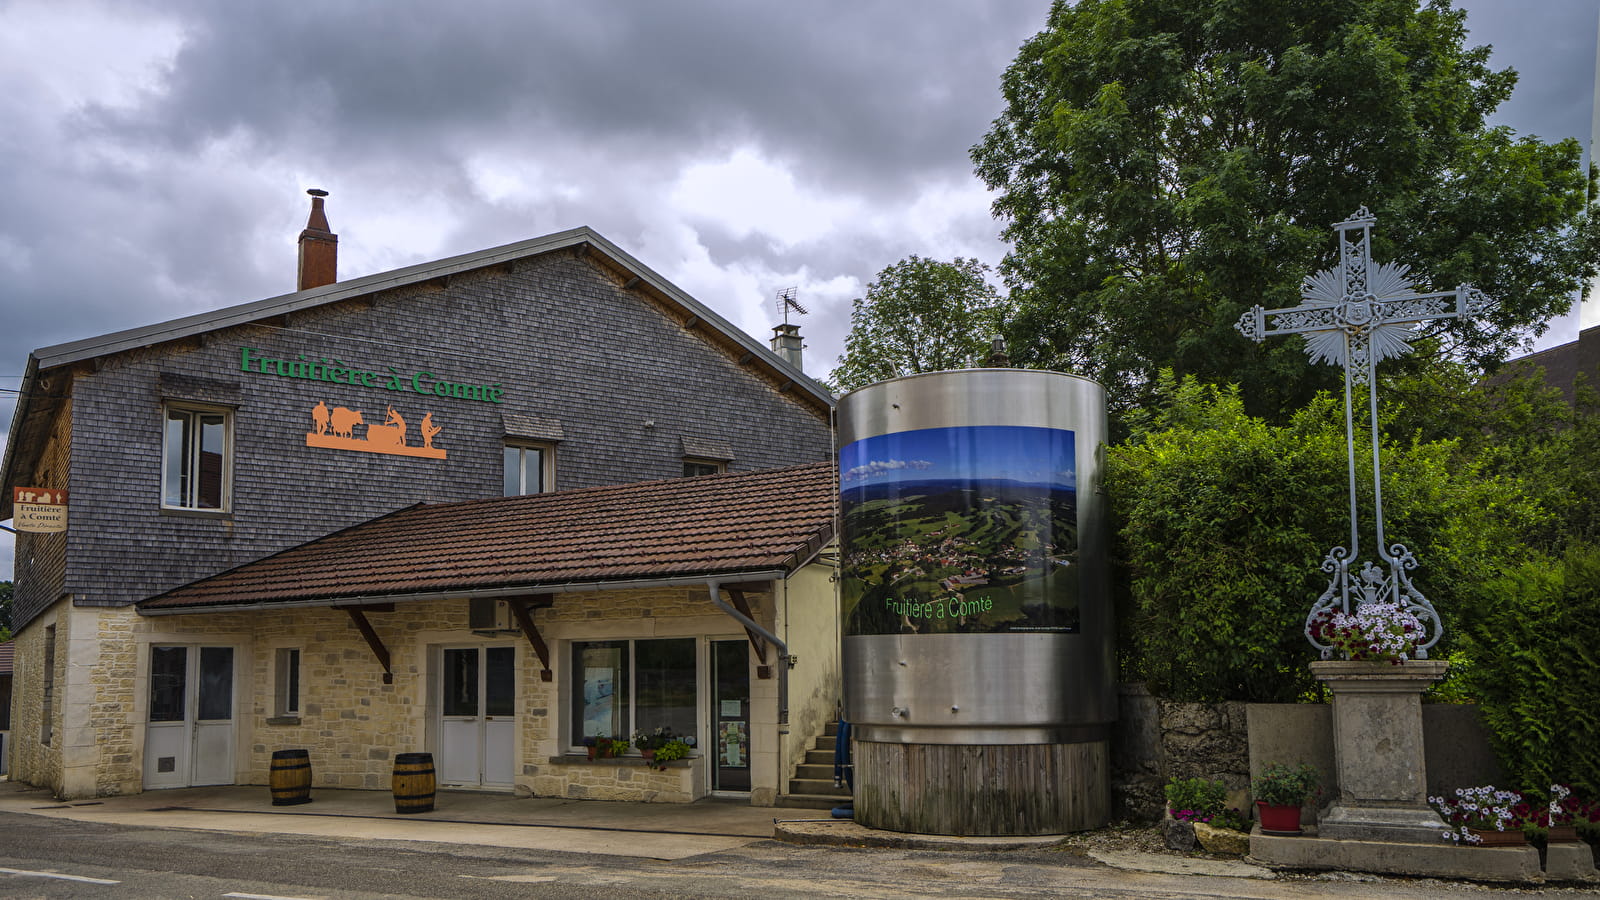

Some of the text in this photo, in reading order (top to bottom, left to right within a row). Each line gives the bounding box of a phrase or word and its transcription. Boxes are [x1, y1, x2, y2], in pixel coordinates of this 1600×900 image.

[240, 347, 504, 403] Fruitière à Comté
[885, 598, 933, 619] Fruitière
[948, 595, 993, 617] Comté
